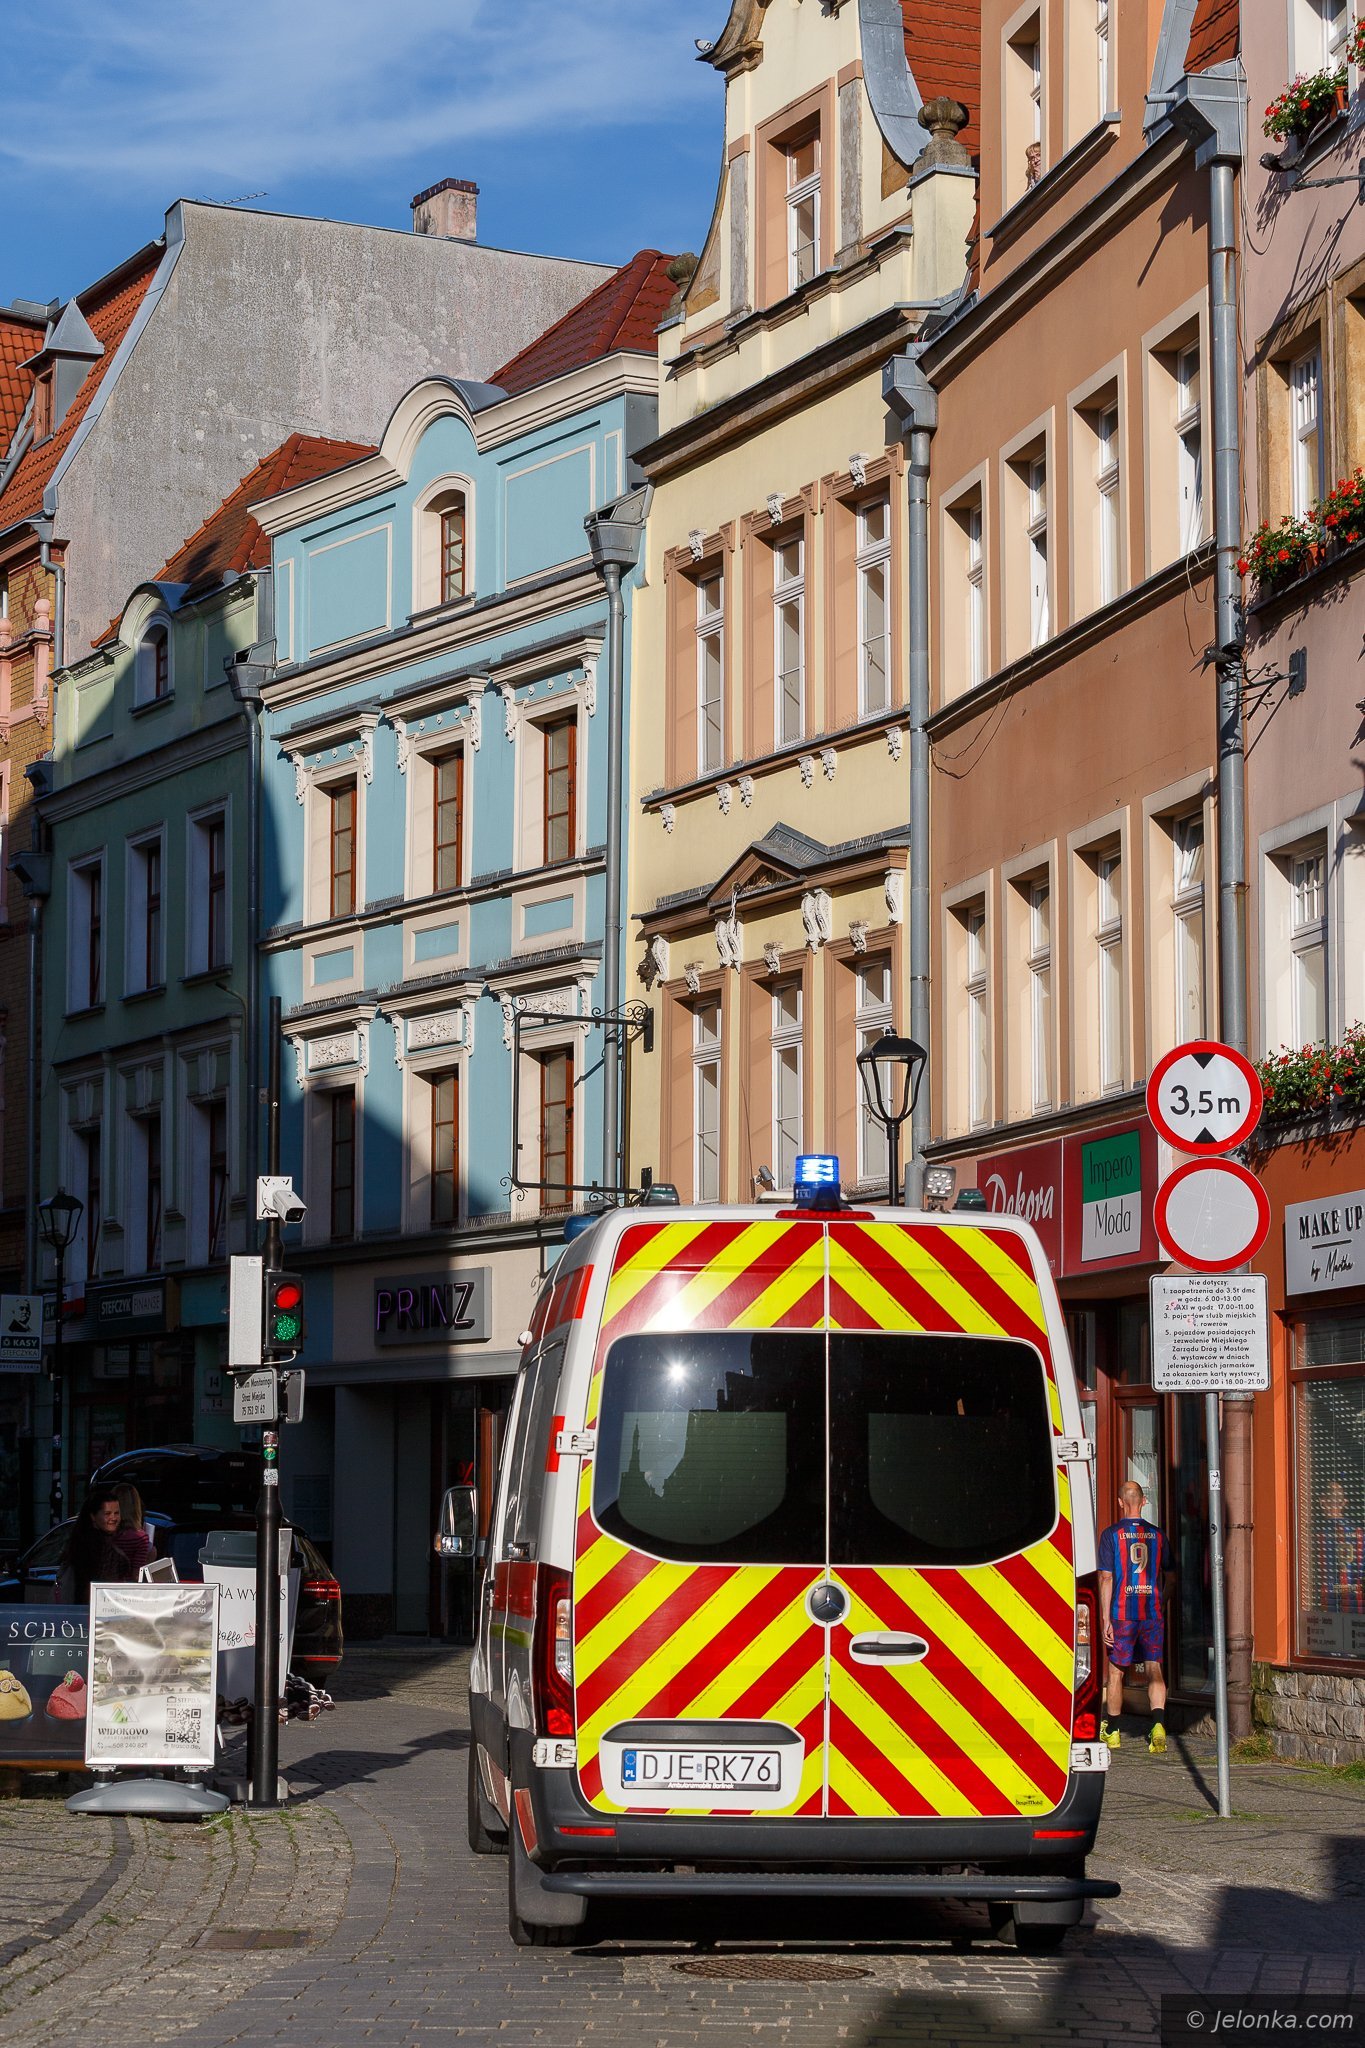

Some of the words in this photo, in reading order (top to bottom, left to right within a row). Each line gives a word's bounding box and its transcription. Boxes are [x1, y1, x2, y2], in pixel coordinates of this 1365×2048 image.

[1089, 1151, 1133, 1196] Impero
[1095, 1198, 1131, 1238] Moda
[1299, 1209, 1340, 1240] MAKE
[1345, 1205, 1363, 1232] UP
[1311, 1259, 1321, 1282] by
[1202, 1279, 1229, 1287] dotyczy:
[1184, 1296, 1203, 1304] godz.
[101, 1298, 132, 1316] STEFCZYK
[376, 1281, 475, 1332] PRINZ
[1225, 1312, 1257, 1320] miejskich
[1173, 1329, 1206, 1337] pojazdów
[1207, 1329, 1256, 1337] posiadających
[13, 1339, 38, 1347] KASY
[1211, 1337, 1248, 1345] Miejskiego
[1181, 1354, 1217, 1362] wystawców
[1167, 1362, 1218, 1371] jeleniogórskich
[1219, 1362, 1255, 1370] jarmarków
[1210, 1370, 1227, 1378] karty
[1228, 1370, 1261, 1378] wystawcy
[1165, 1379, 1184, 1387] godz.
[252, 1391, 266, 1402] Miejska
[1130, 1542, 1148, 1574] 9
[237, 1588, 287, 1601] WYS
[31, 1649, 55, 1657] ICE
[98, 1727, 149, 1736] WIDOKOVO
[643, 1754, 694, 1780] DJE
[705, 1755, 772, 1782] RK76
[625, 1770, 635, 1778] PL
